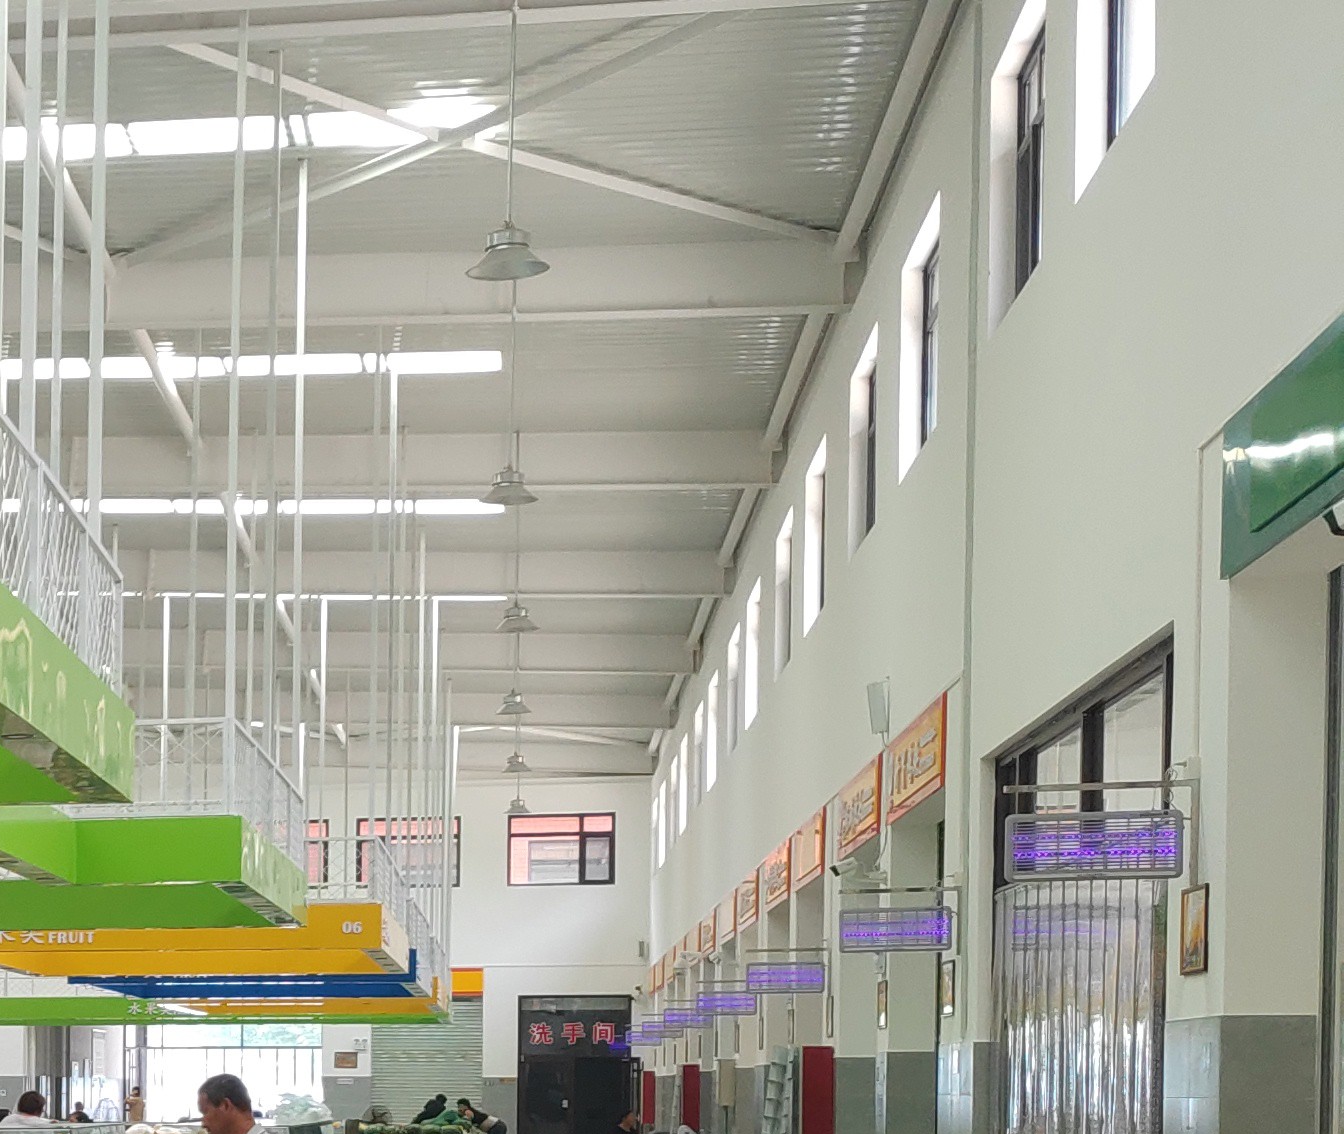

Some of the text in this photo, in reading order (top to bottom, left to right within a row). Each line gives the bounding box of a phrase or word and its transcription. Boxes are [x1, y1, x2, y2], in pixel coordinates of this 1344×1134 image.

[342, 921, 363, 934] 06
[47, 930, 95, 944] FRUIT
[528, 1021, 616, 1045] 洗手间
